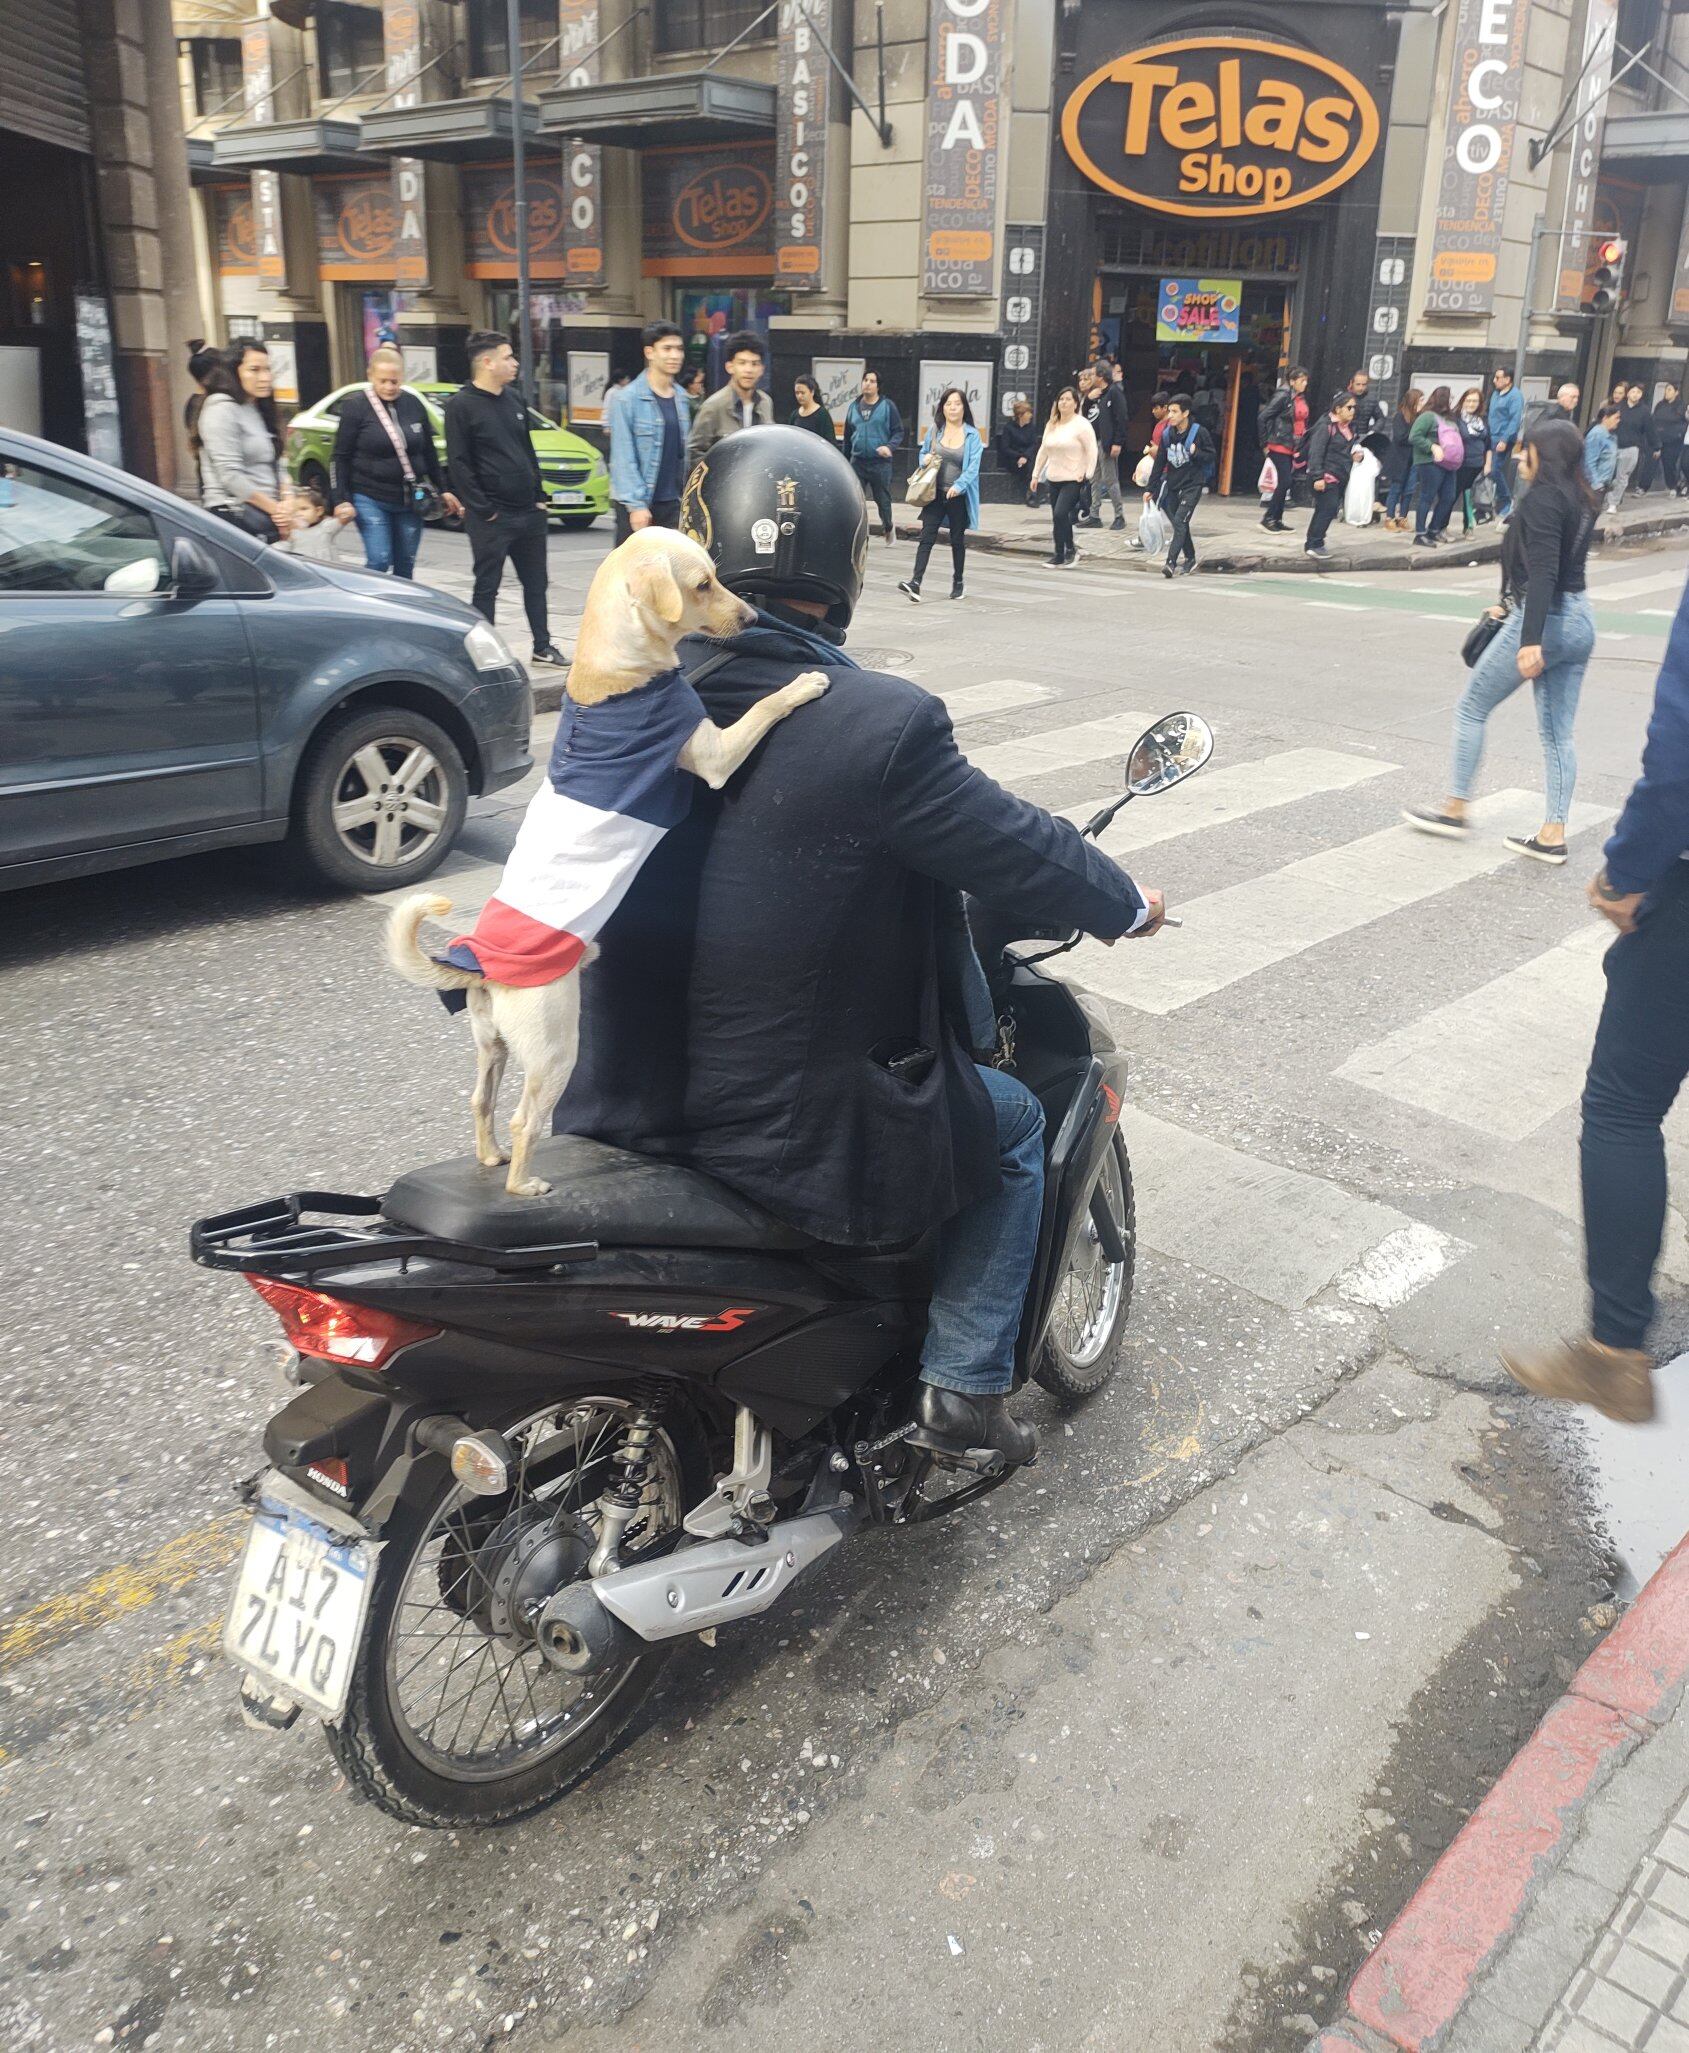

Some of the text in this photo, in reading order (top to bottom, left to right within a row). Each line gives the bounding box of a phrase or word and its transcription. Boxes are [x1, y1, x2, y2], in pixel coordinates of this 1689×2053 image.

[790, 27, 811, 237] BASICOS
[1109, 58, 1355, 163] Telas
[965, 148, 982, 199] DECO
[1179, 153, 1292, 203] Shop
[1571, 76, 1601, 249] NOCHE
[1474, 172, 1494, 220] DECO
[1177, 305, 1220, 327] SALE
[1183, 292, 1220, 305] SHOP
[616, 1313, 710, 1329] WAVE
[306, 1467, 347, 1498] HONDA
[238, 1593, 336, 1694] 7LYQ
